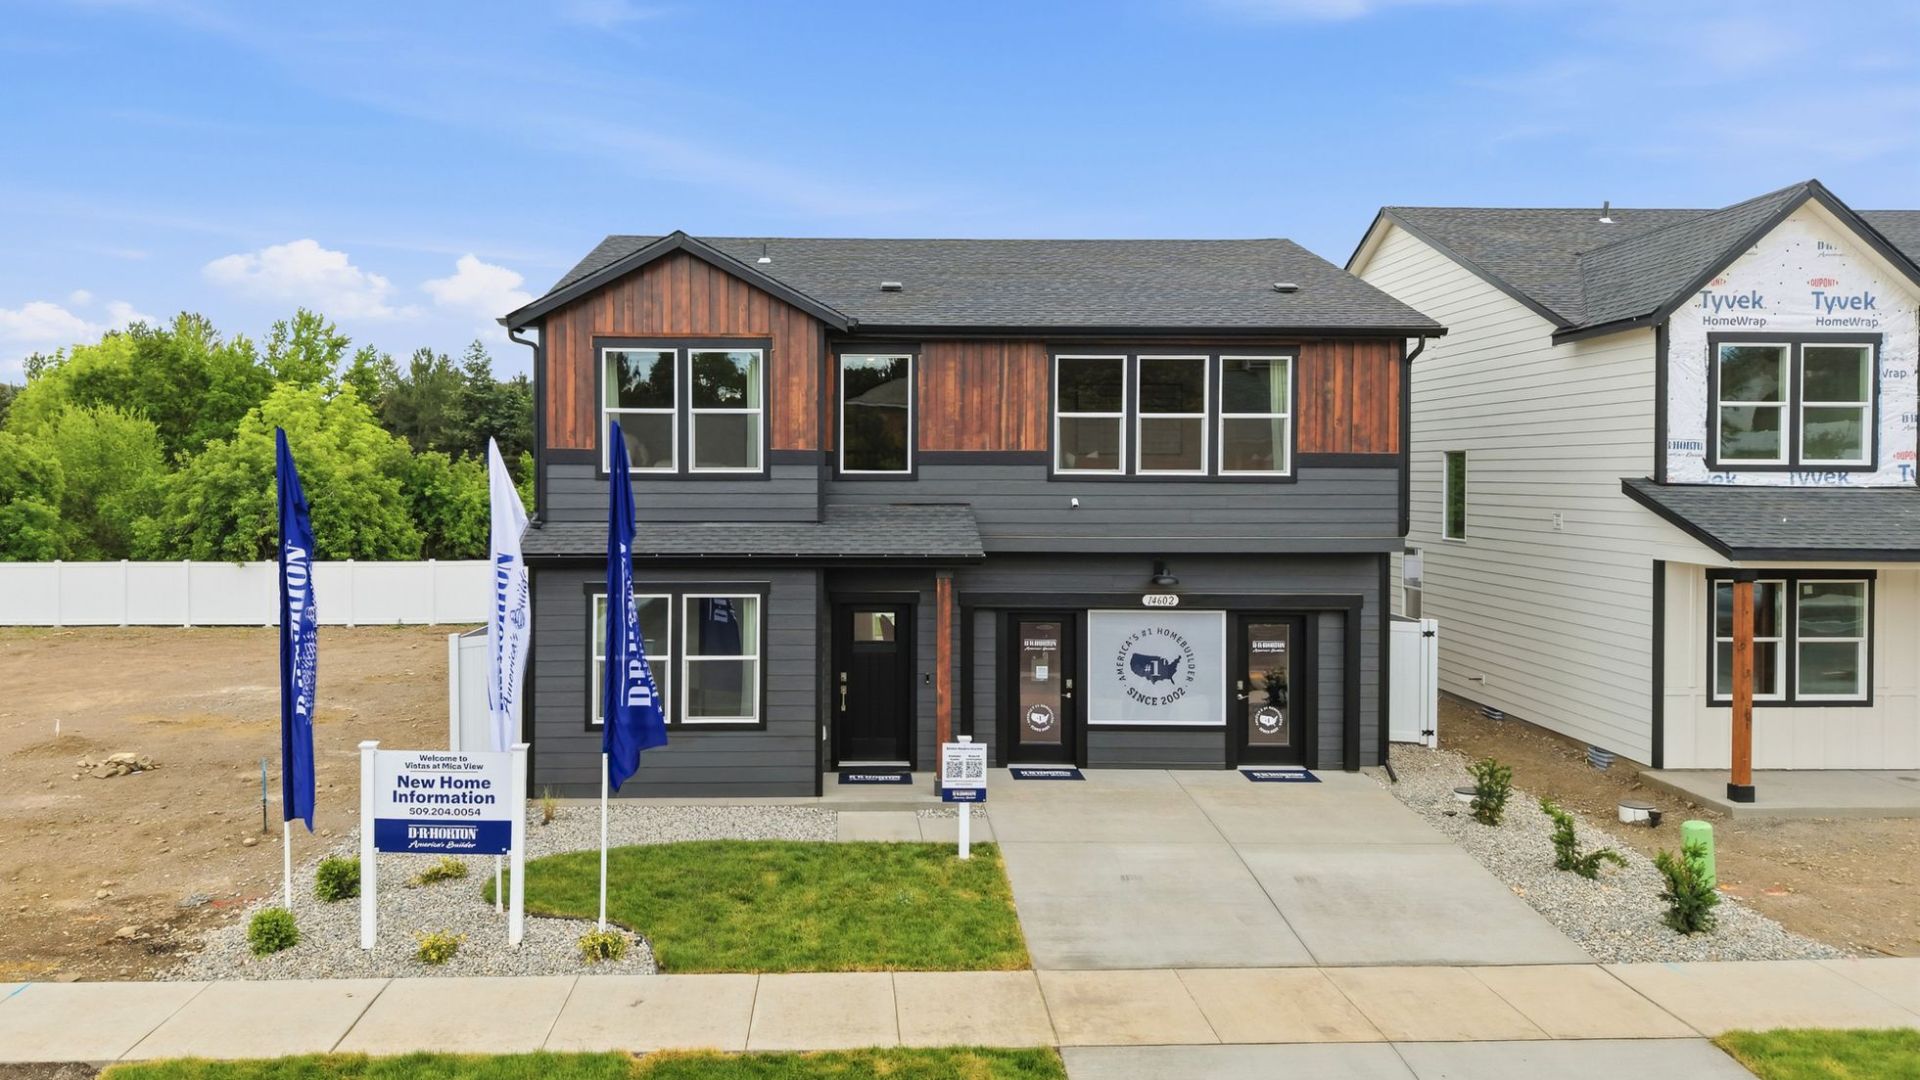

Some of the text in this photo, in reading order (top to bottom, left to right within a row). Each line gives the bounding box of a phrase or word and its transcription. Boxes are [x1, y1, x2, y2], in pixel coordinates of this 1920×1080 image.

[1810, 278, 1836, 288] DUPONT
[1699, 290, 1764, 314] Tyvek
[1811, 291, 1876, 315] Tyvek
[1702, 316, 1767, 328] HomeWrap
[1816, 316, 1879, 329] HomeWrap
[1147, 595, 1175, 605] 14602
[1115, 627, 1195, 682] AMERICA'S #1 HOMEBUILDER
[1143, 660, 1161, 677] #1
[1126, 687, 1186, 706] SINCE 2002
[419, 754, 458, 762] Welcome
[404, 762, 431, 770] Vistas
[442, 762, 462, 770] Mica
[397, 775, 491, 789] New Home
[392, 790, 495, 804] Information
[409, 807, 481, 816] 509.204.0054
[408, 840, 476, 849] America's Builder
